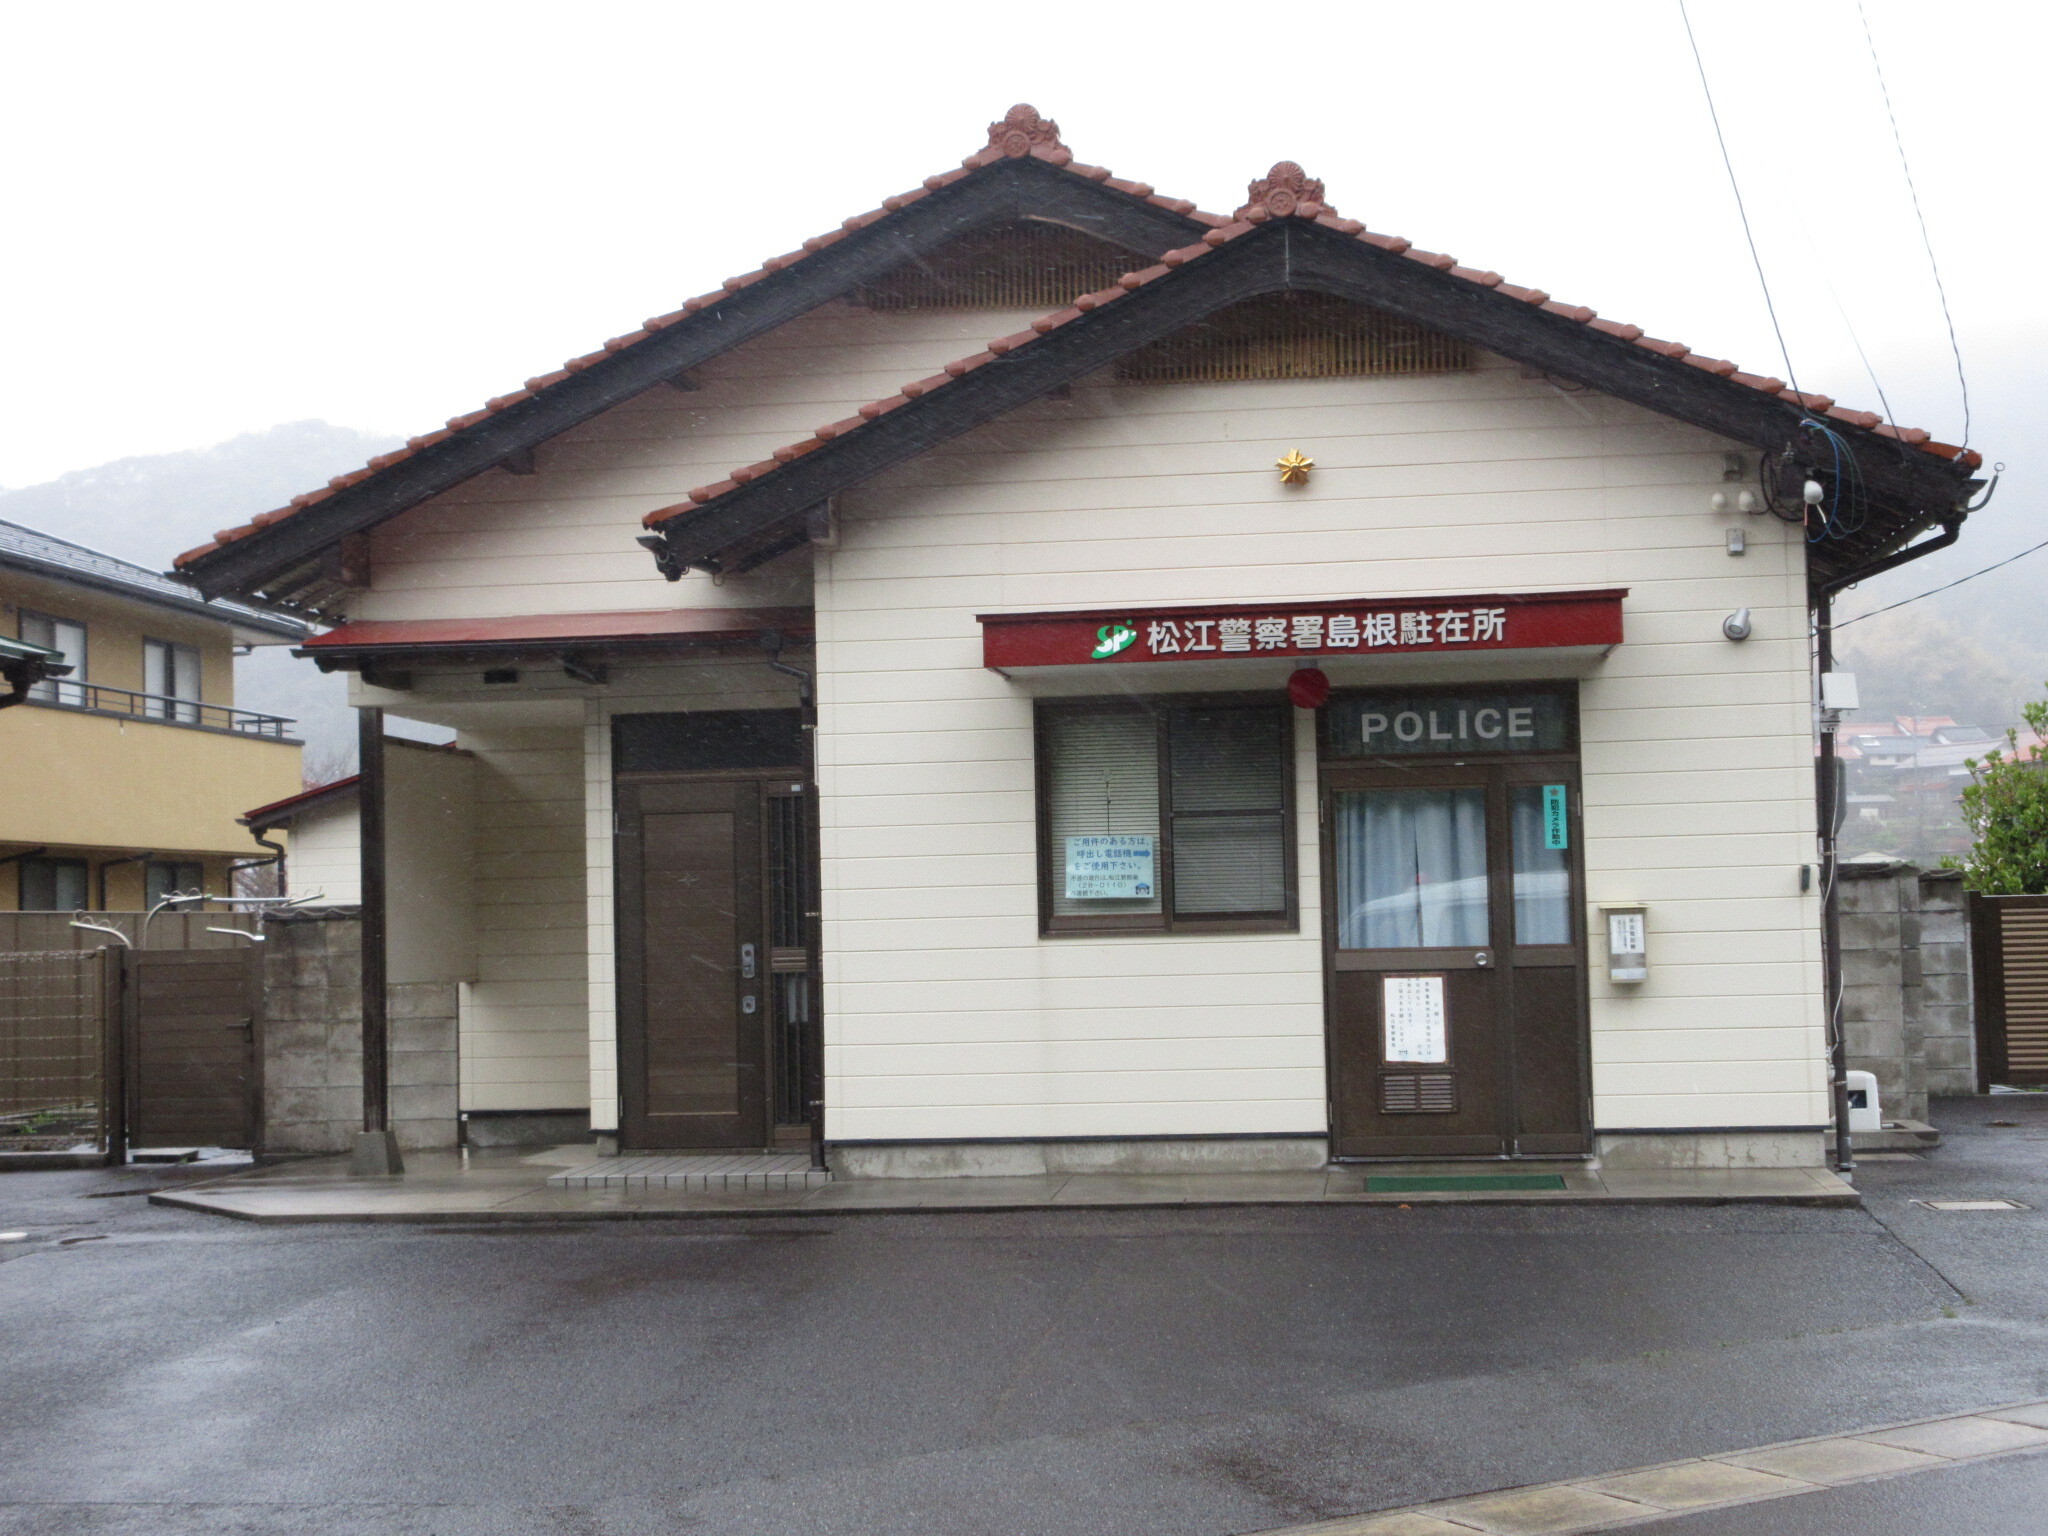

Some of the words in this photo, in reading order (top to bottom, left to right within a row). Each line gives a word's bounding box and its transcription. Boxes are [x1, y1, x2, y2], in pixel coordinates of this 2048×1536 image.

[1147, 607, 1507, 655] 松江警察署島根駐在所
[1361, 707, 1534, 743] POLICE
[1076, 849, 1133, 859] 呼出し電話機
[1074, 861, 1142, 871] をご使用下さい。
